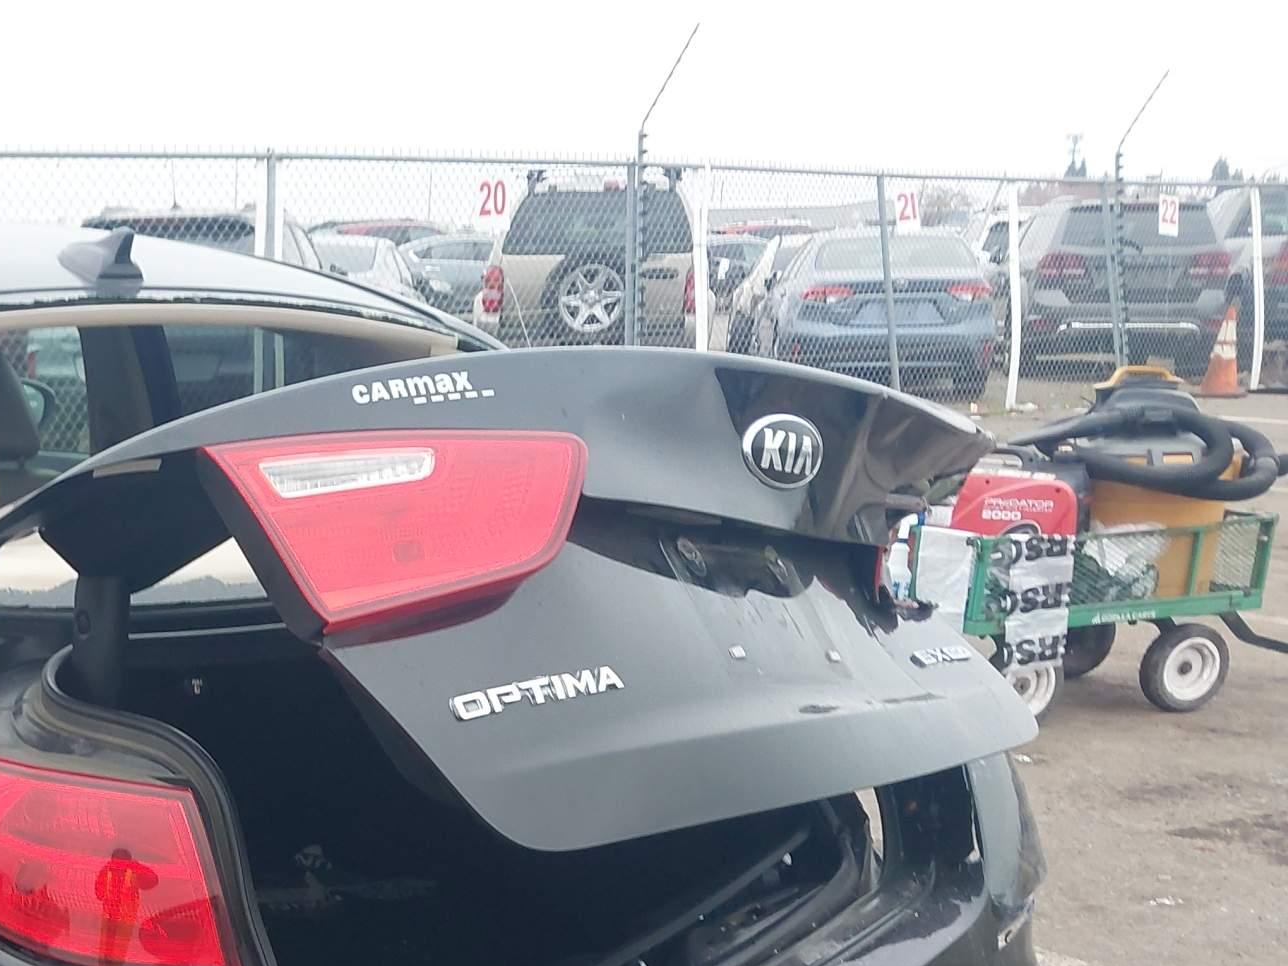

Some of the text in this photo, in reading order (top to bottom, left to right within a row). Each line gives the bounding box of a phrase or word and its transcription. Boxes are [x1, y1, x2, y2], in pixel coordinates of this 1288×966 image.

[479, 180, 506, 217] 20
[897, 192, 917, 221] 21
[1161, 199, 1177, 225] 22
[760, 427, 812, 477] KIA
[984, 497, 1054, 508] PREDATOR
[449, 665, 625, 721] OPTIMA
